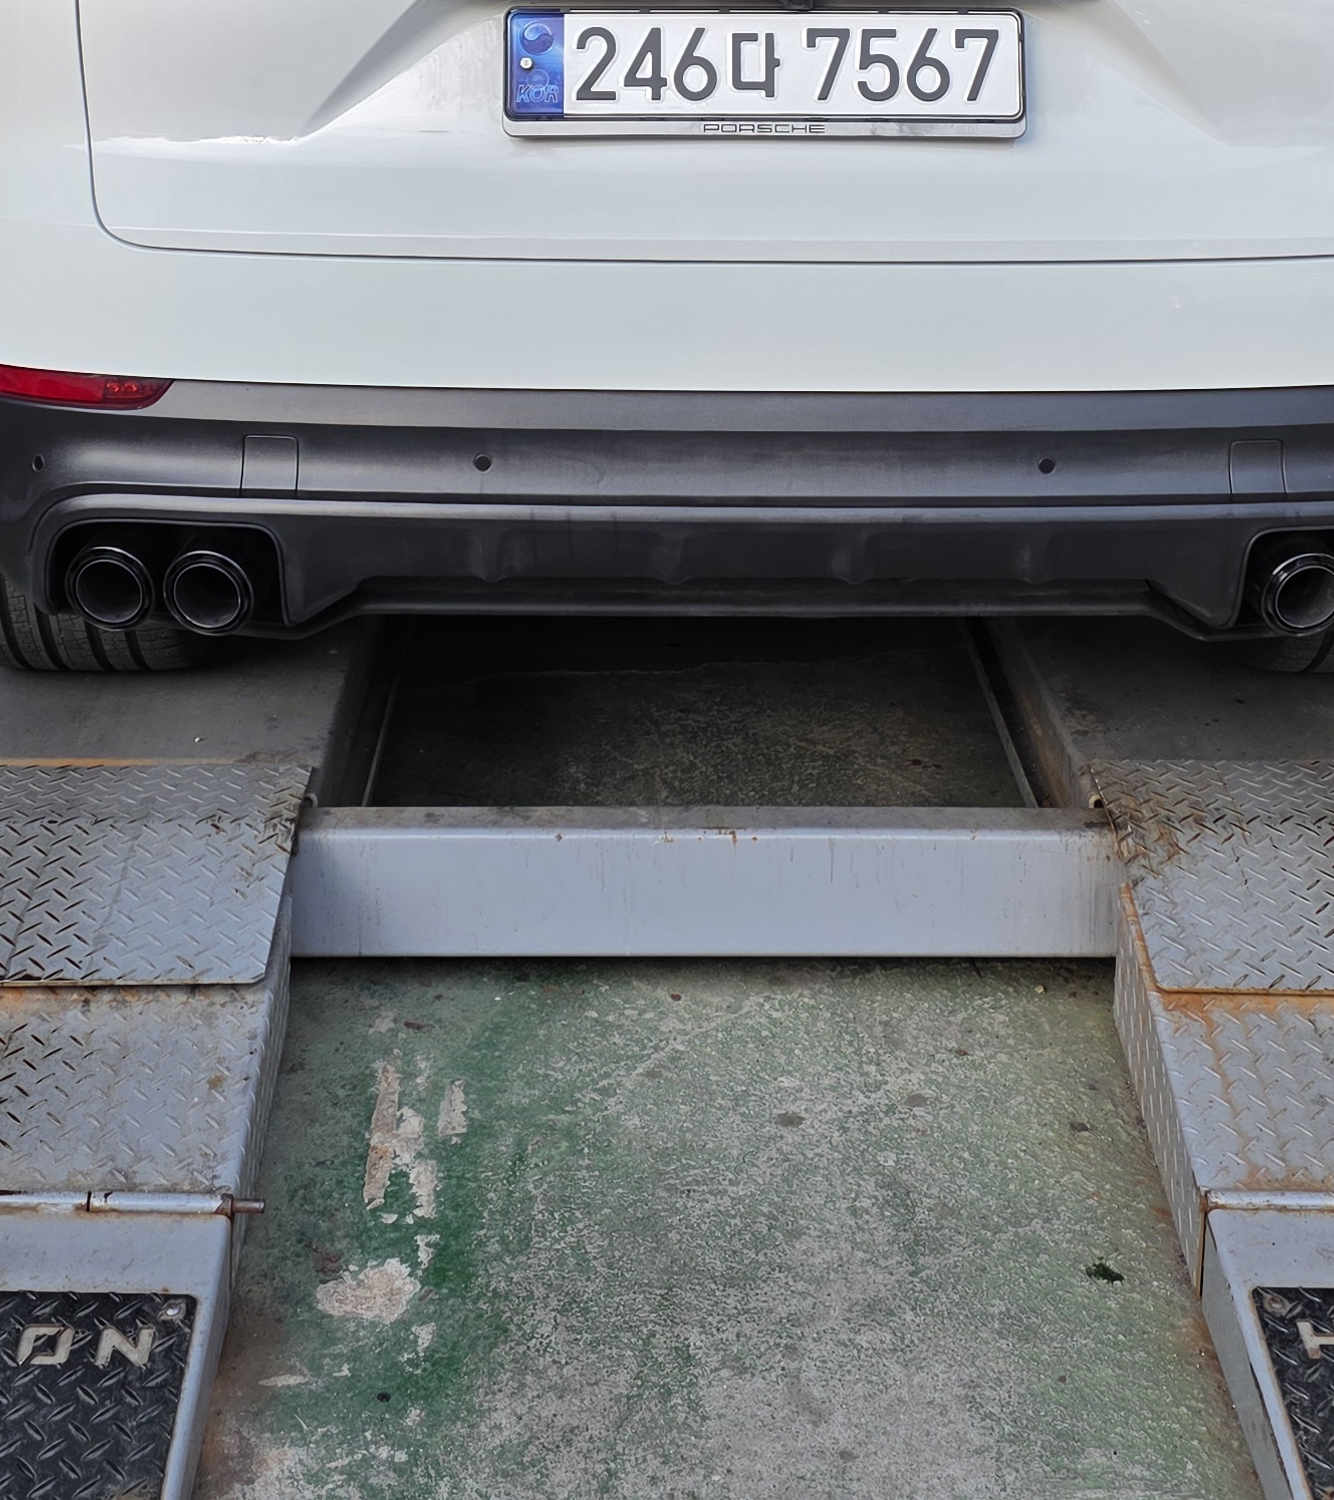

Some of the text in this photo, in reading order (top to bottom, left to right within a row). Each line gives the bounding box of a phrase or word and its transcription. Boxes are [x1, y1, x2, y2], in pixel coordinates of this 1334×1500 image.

[576, 26, 999, 102] 246다 7567
[516, 84, 560, 104] KOR
[703, 123, 826, 134] PORSCHE
